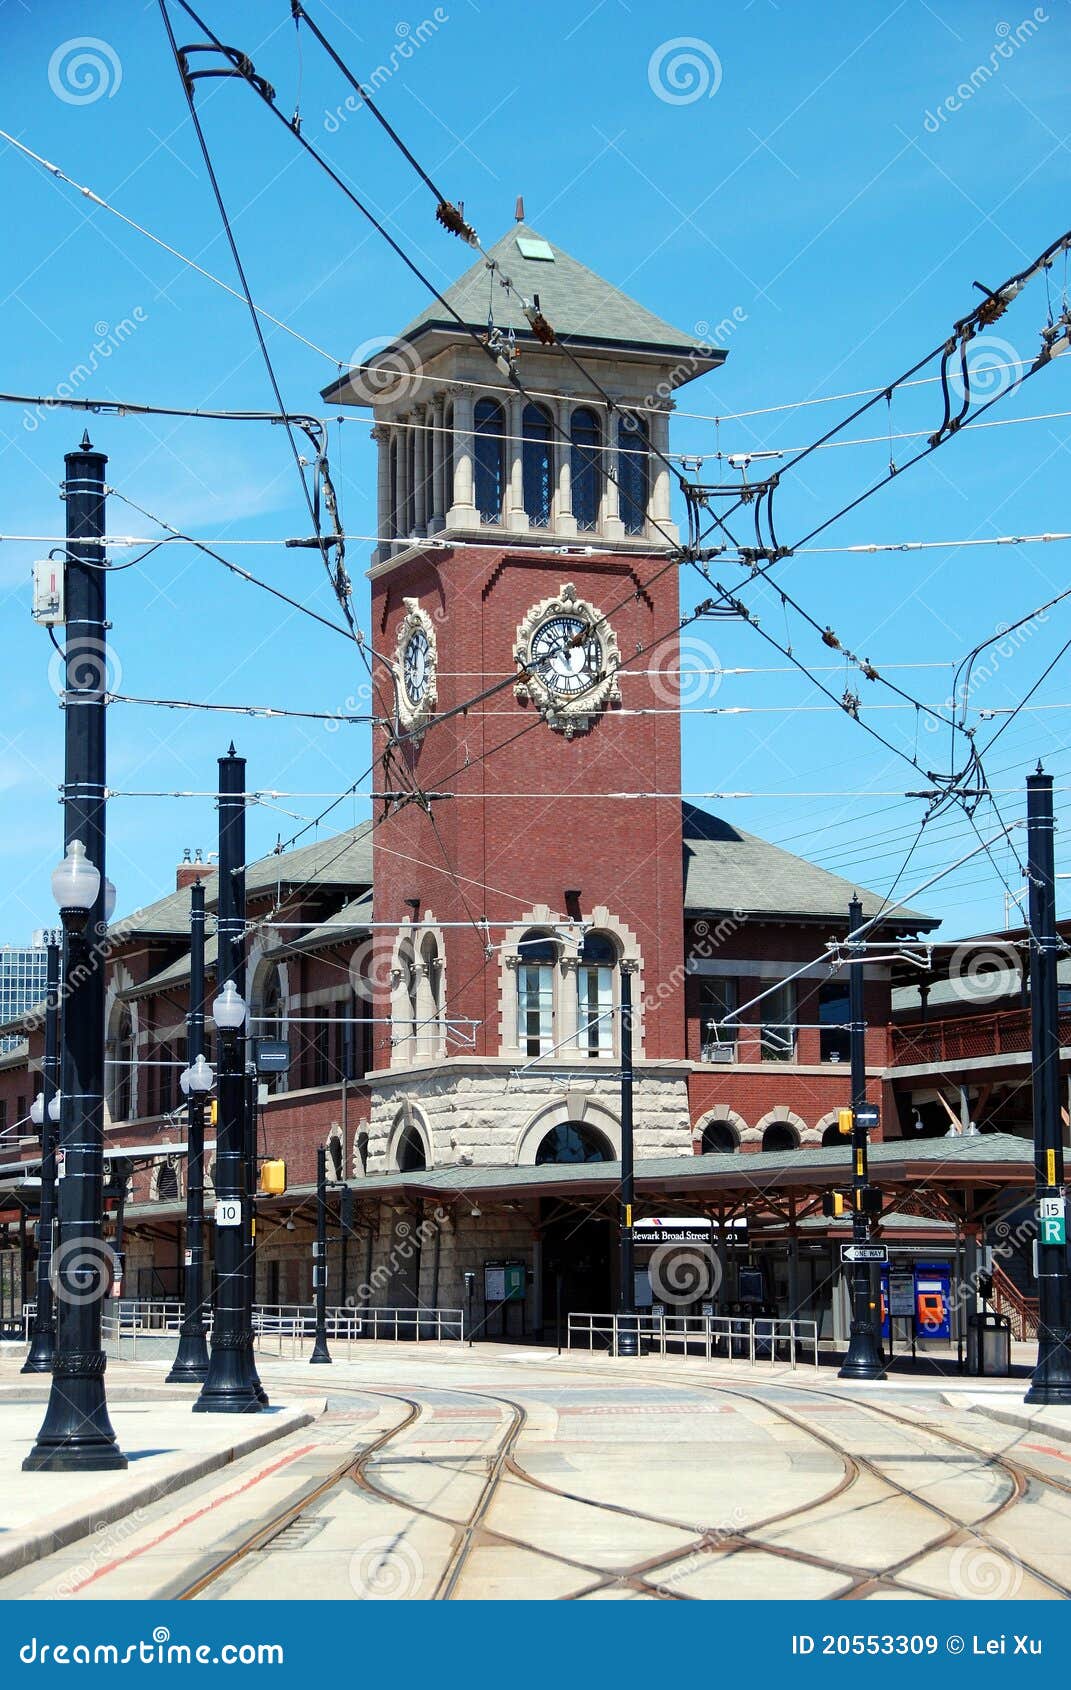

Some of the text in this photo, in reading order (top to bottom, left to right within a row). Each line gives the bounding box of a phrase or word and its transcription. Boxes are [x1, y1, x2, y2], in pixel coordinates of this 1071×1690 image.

[222, 1206, 236, 1219] 10
[1046, 1204, 1059, 1216] 15
[661, 1230, 685, 1240] Broad
[686, 1230, 709, 1240] Street
[1045, 1220, 1061, 1241] R
